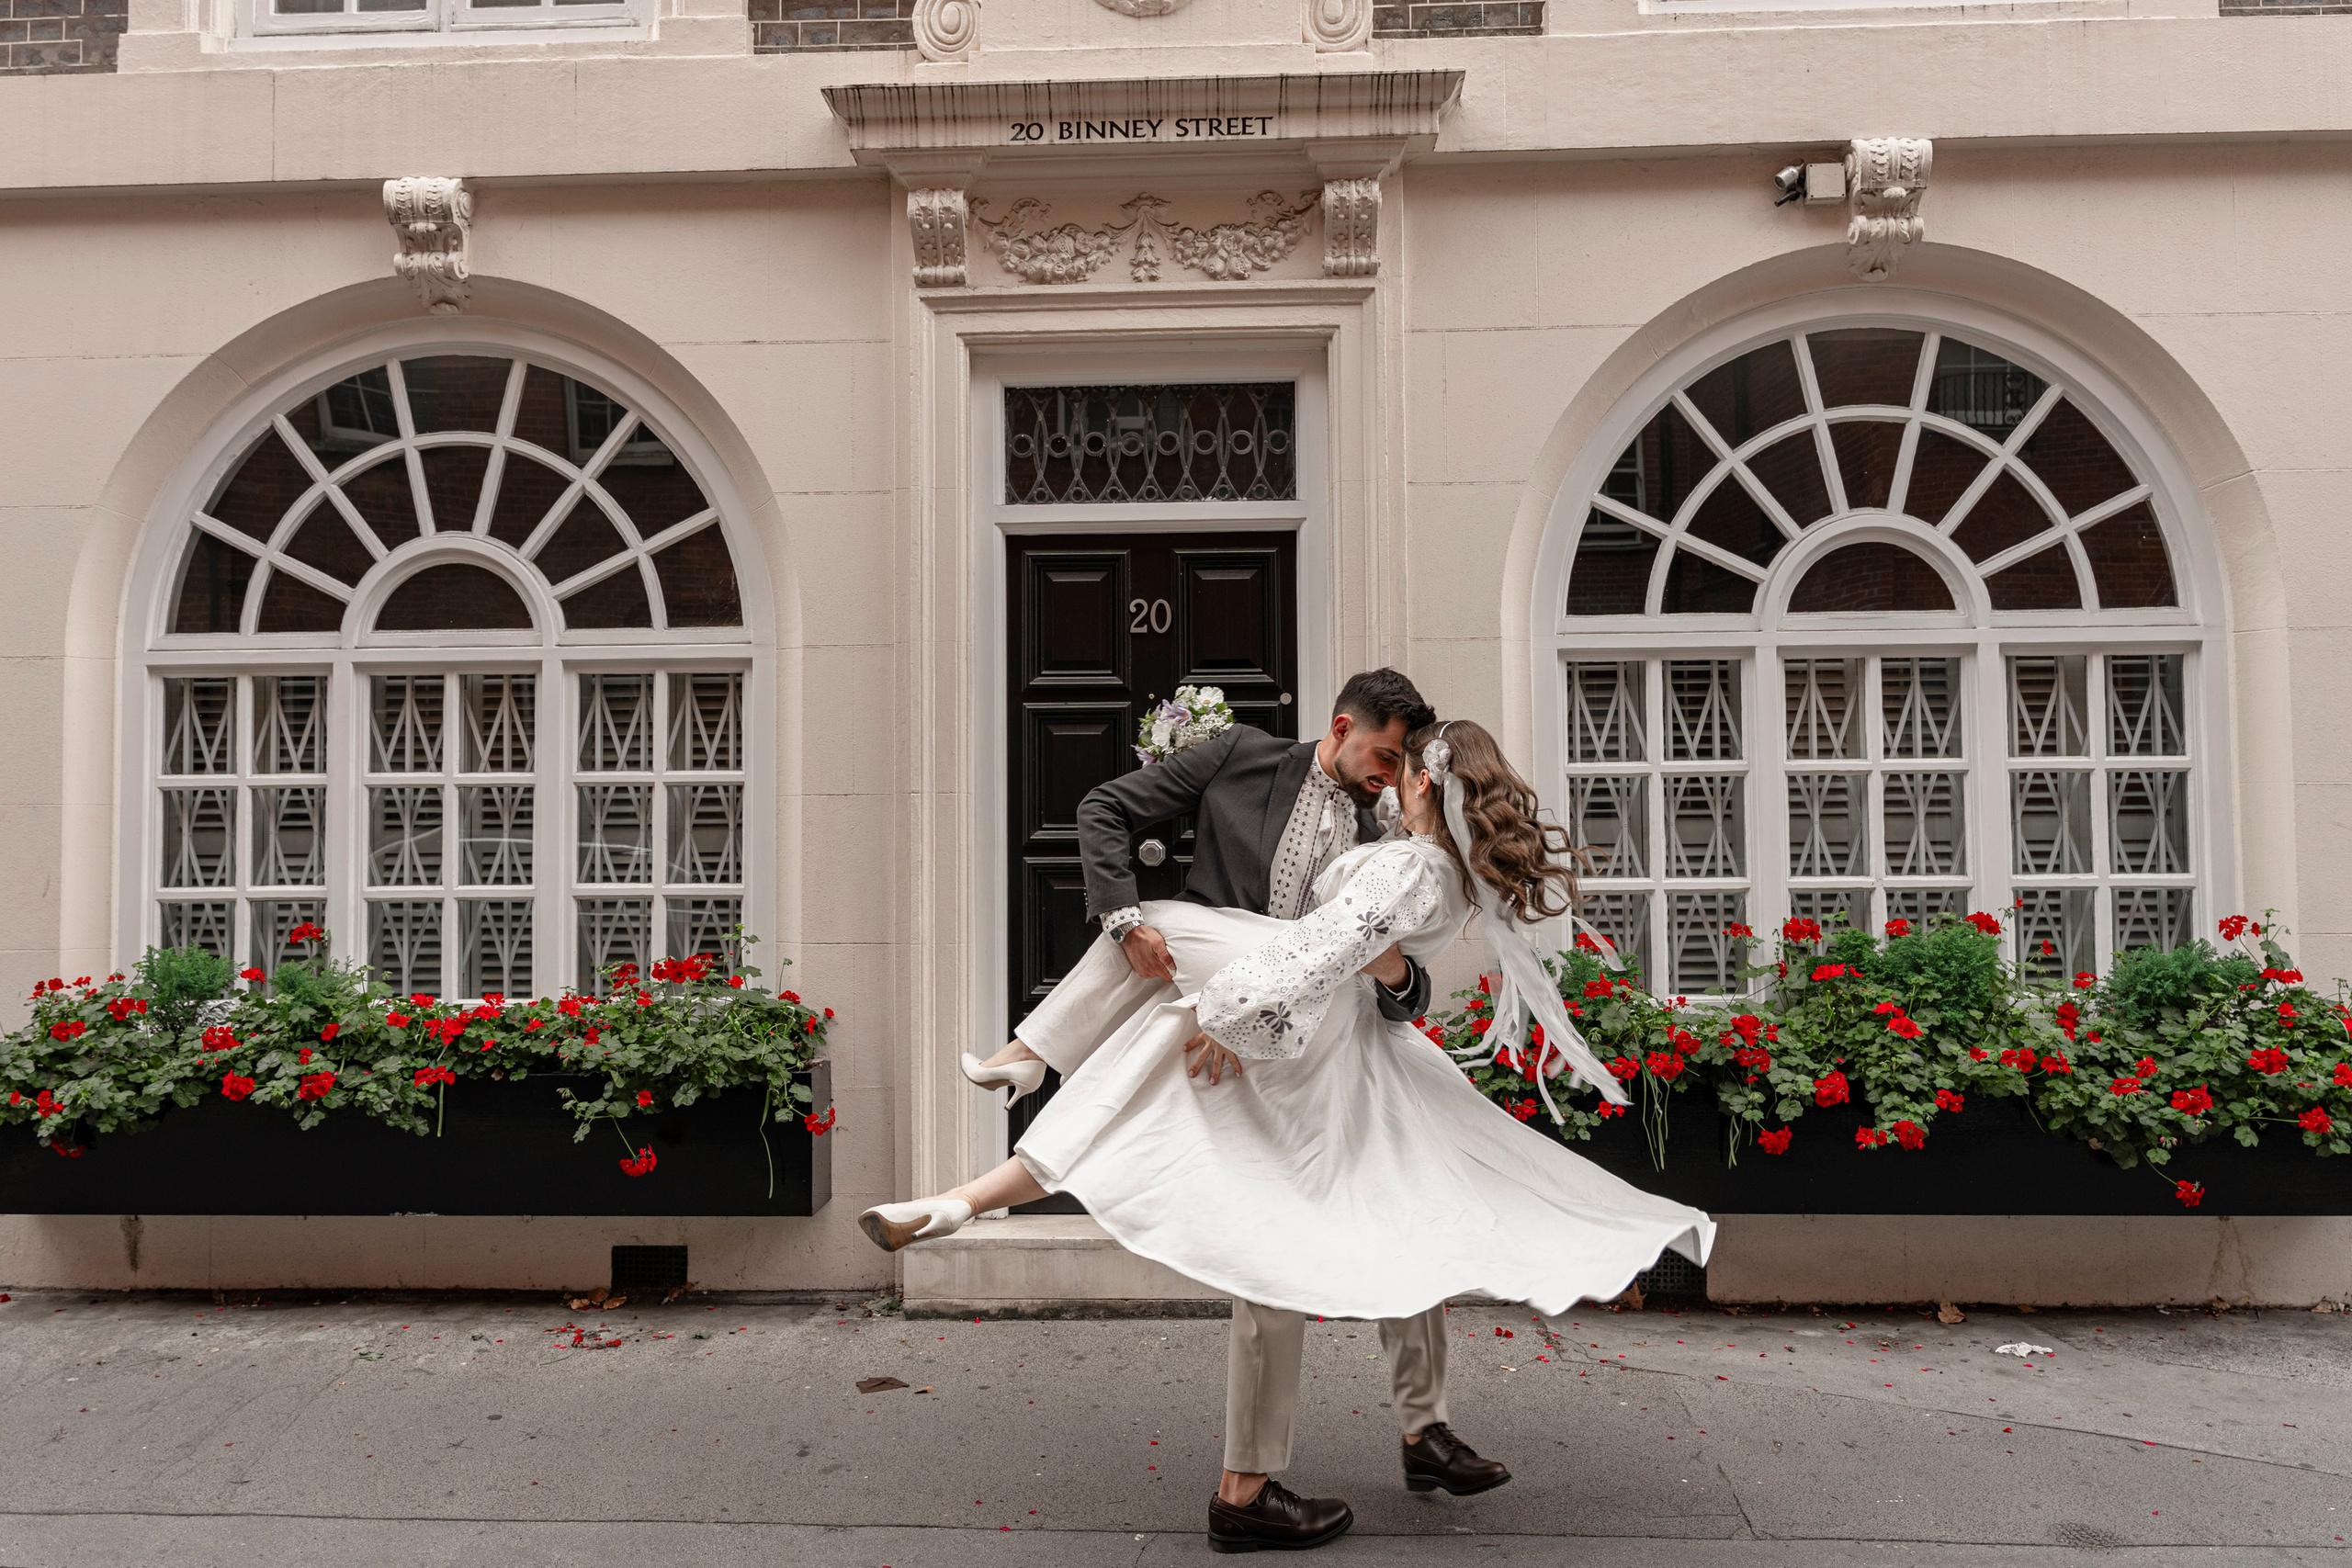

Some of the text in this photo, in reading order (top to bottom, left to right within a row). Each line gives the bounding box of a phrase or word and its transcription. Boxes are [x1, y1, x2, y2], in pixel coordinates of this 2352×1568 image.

[1010, 116, 1274, 141] 20 BINNEY STREET
[1129, 598, 1171, 634] 20
